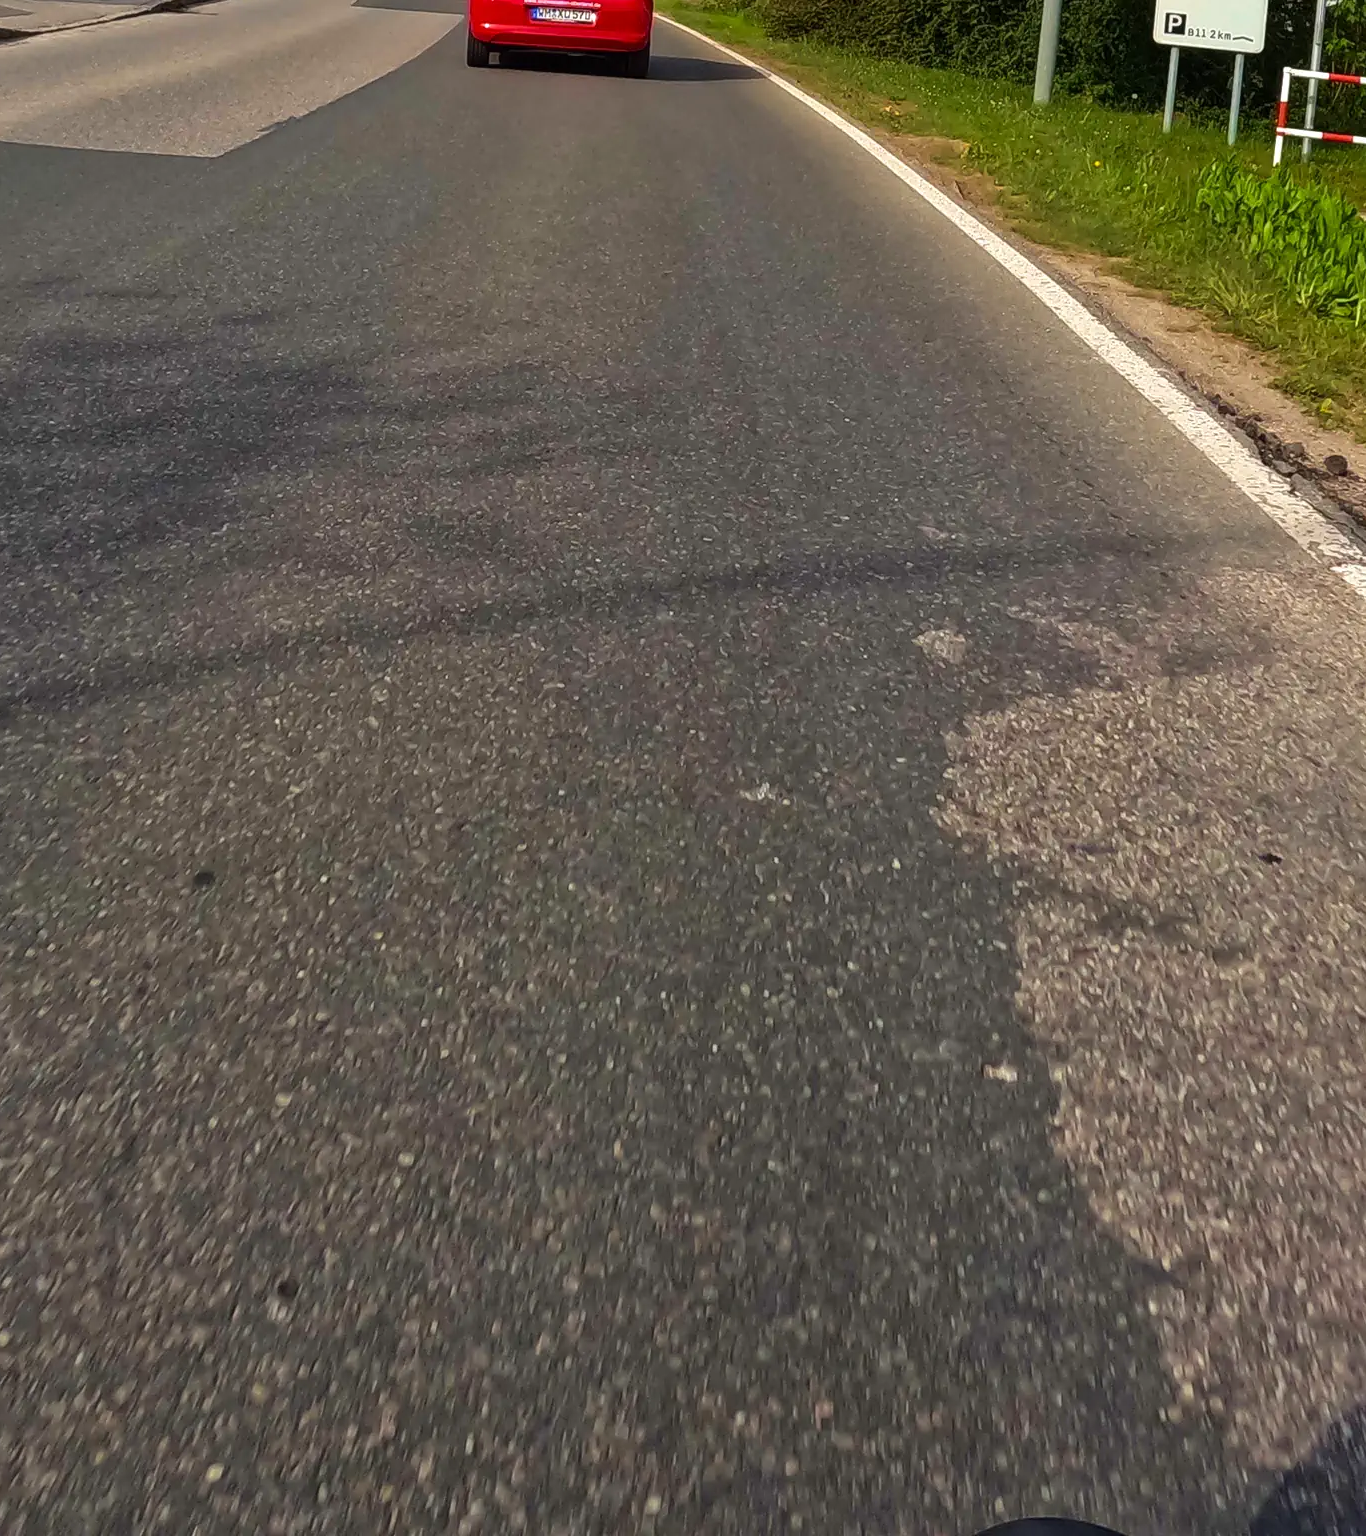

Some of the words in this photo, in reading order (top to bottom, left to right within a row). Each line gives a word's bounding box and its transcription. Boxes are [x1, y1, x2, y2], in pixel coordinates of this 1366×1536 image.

[1167, 14, 1183, 33] P
[1187, 27, 1207, 38] B11
[1209, 29, 1216, 39] 2
[1217, 30, 1232, 41] km
